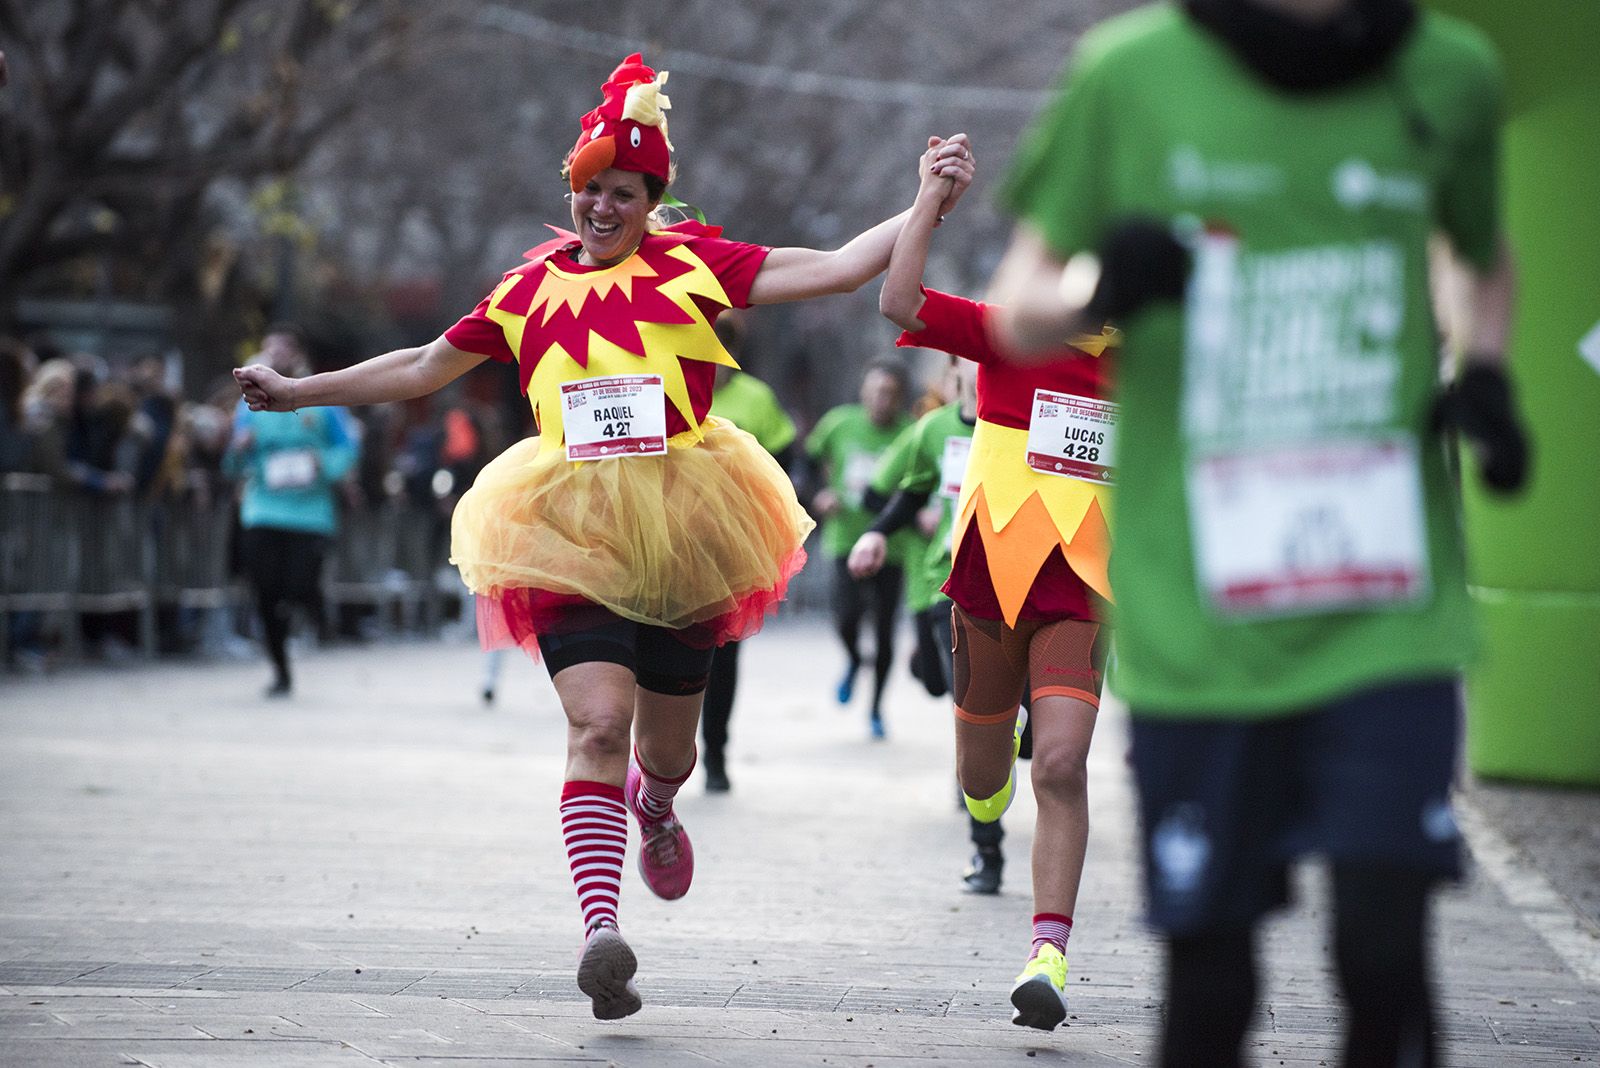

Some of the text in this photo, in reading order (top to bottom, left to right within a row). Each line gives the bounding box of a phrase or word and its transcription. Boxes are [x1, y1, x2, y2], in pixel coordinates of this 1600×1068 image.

[593, 406, 634, 422] RAQUEL
[1079, 408, 1103, 419] DESEMBRE
[602, 421, 631, 438] 427
[1064, 426, 1105, 445] LUCAS
[1062, 443, 1100, 462] 428
